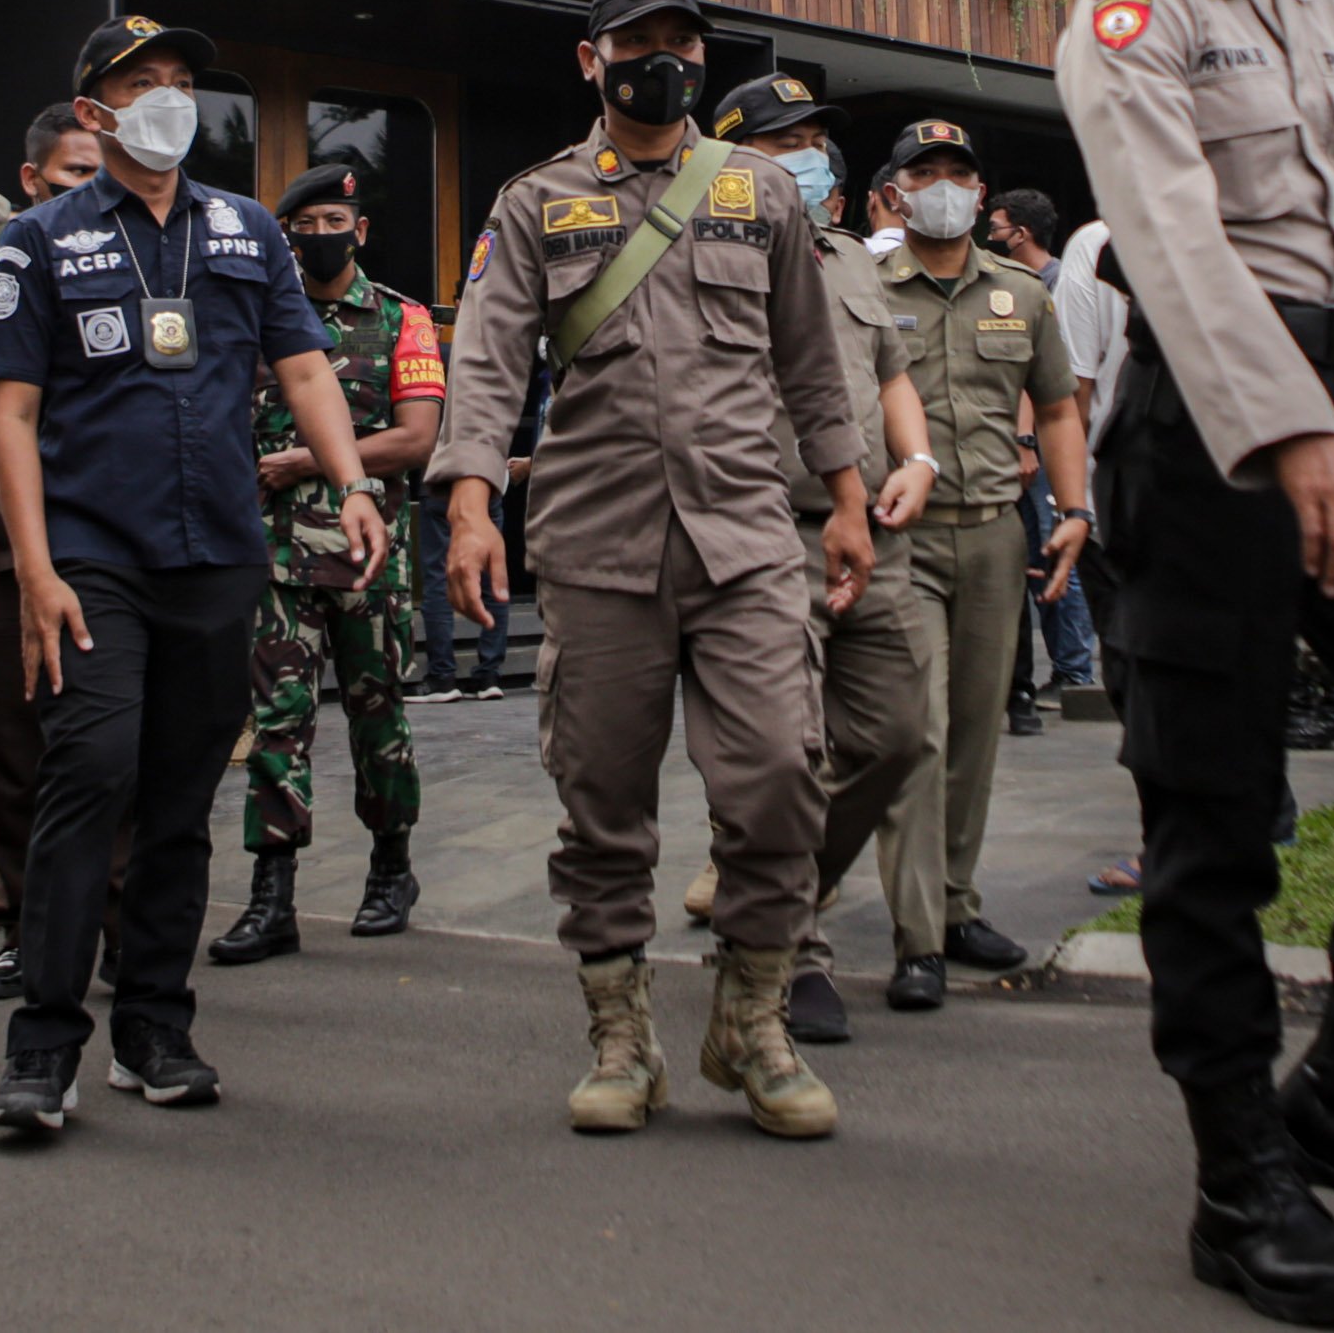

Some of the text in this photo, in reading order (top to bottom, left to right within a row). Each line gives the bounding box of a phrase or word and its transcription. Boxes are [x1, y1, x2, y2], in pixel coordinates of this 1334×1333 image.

[697, 221, 765, 243] POL PP
[207, 238, 260, 258] PPNS
[60, 252, 123, 277] ACEP
